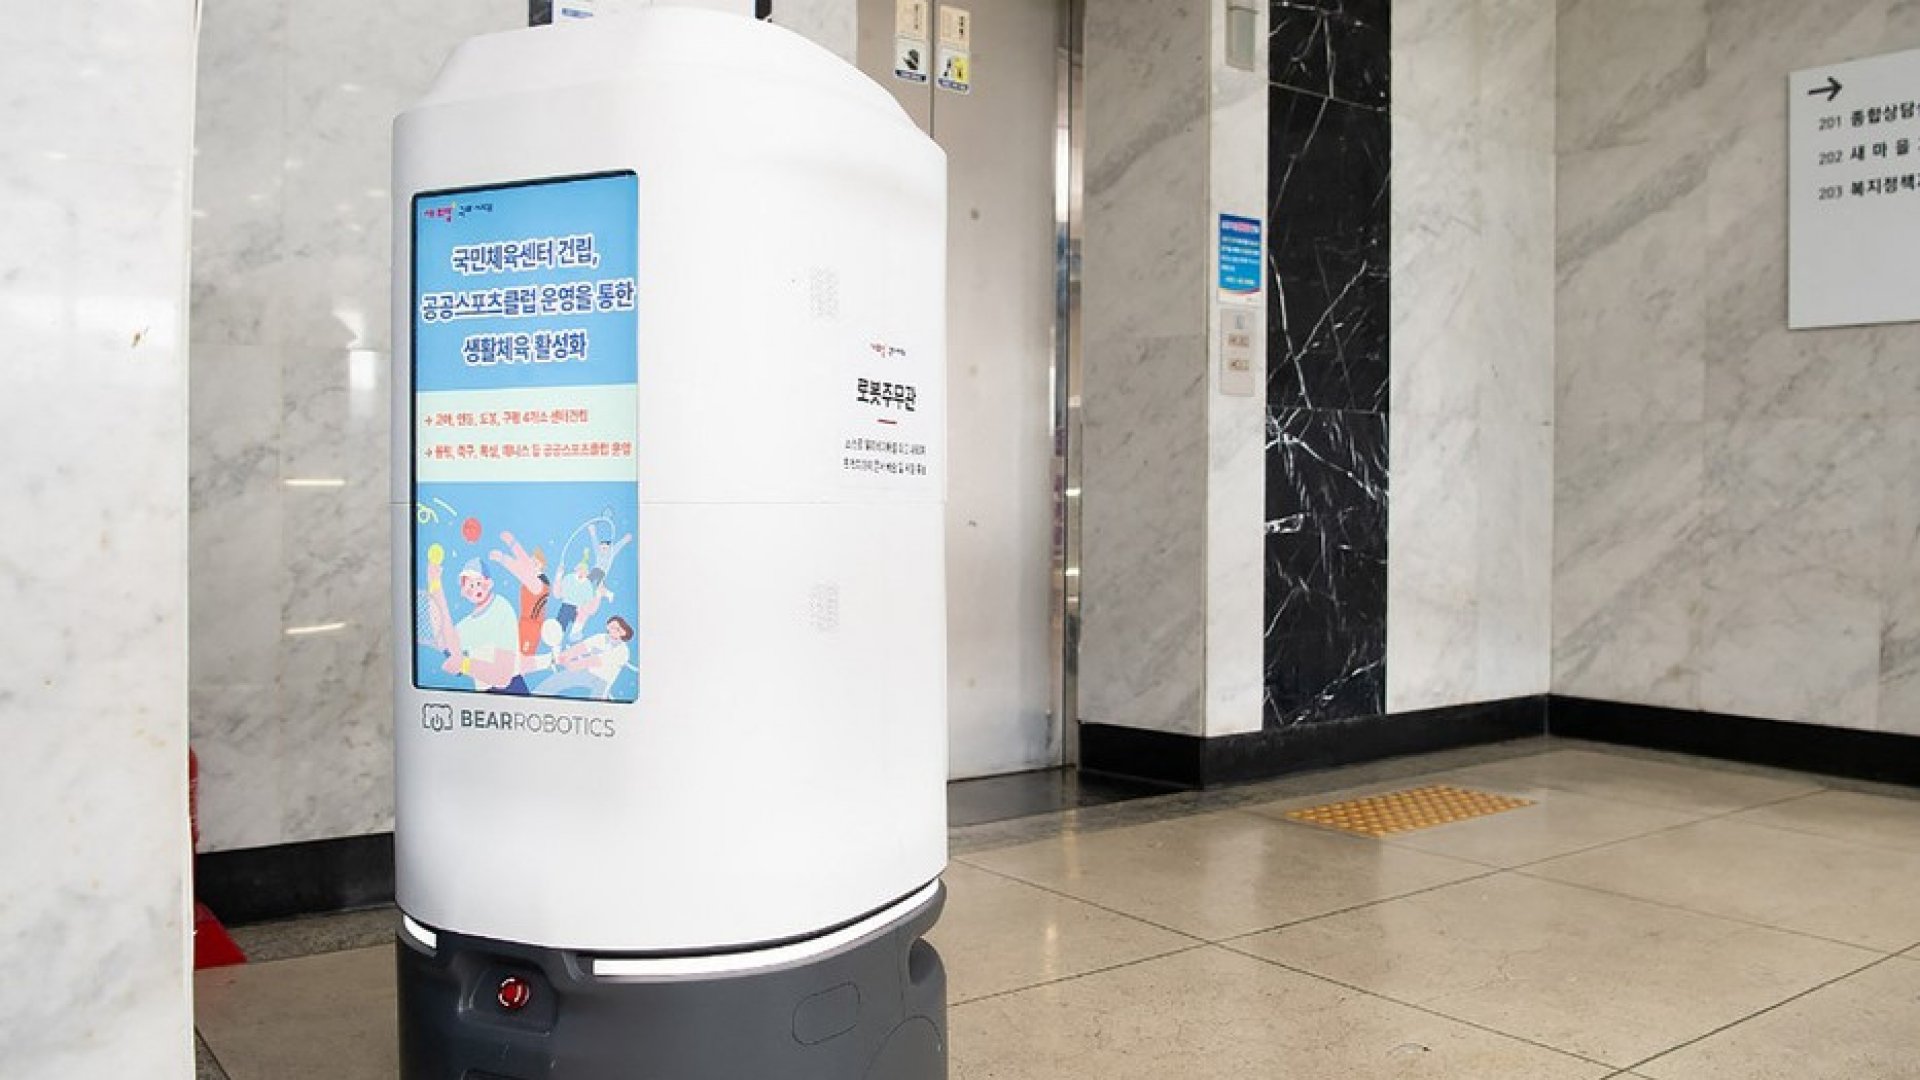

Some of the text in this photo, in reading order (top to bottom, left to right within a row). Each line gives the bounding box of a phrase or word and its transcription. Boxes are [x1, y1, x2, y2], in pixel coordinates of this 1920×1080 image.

[1818, 100, 1920, 131] 201 종합상담
[1818, 150, 1843, 165] 202
[1851, 172, 1920, 197] 복지정책
[453, 234, 600, 275] 국민체육센터 건립,
[422, 280, 636, 322] 공공스포츠클럽 운영을 통한
[463, 330, 588, 364] 생활체육 활성화
[856, 377, 917, 412] 로봇주무관
